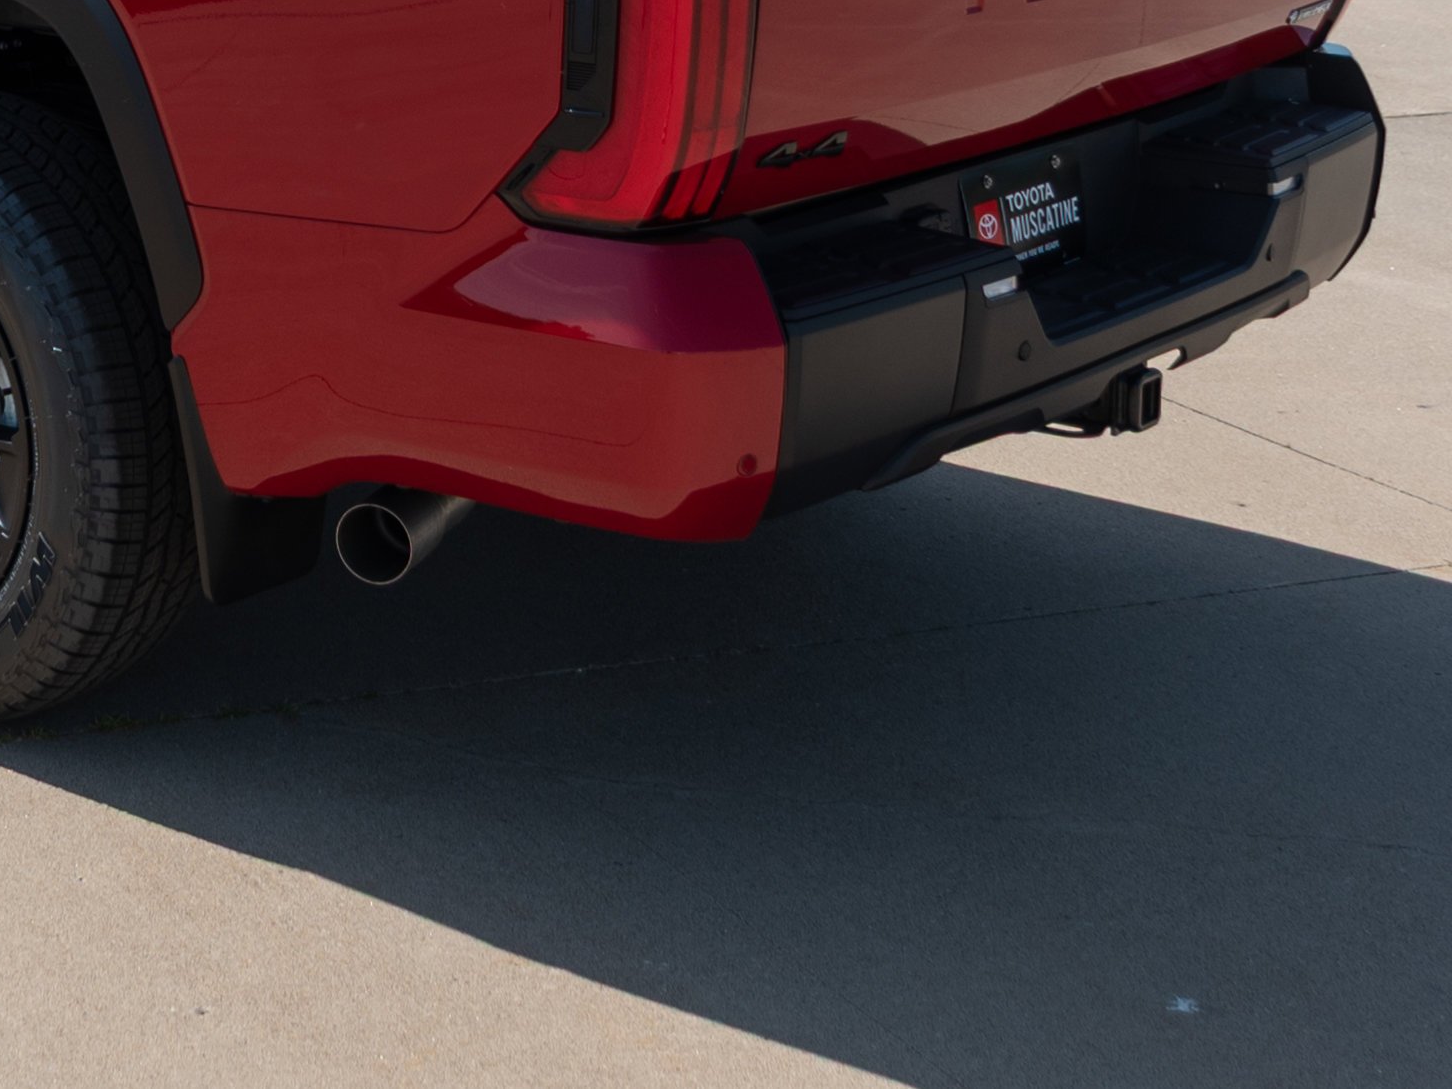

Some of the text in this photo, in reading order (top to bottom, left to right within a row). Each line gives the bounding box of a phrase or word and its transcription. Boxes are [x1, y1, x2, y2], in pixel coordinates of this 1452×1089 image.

[756, 129, 848, 169] 4x4
[1005, 182, 1055, 212] TOYOTA
[1010, 196, 1080, 244] MUSCATINE
